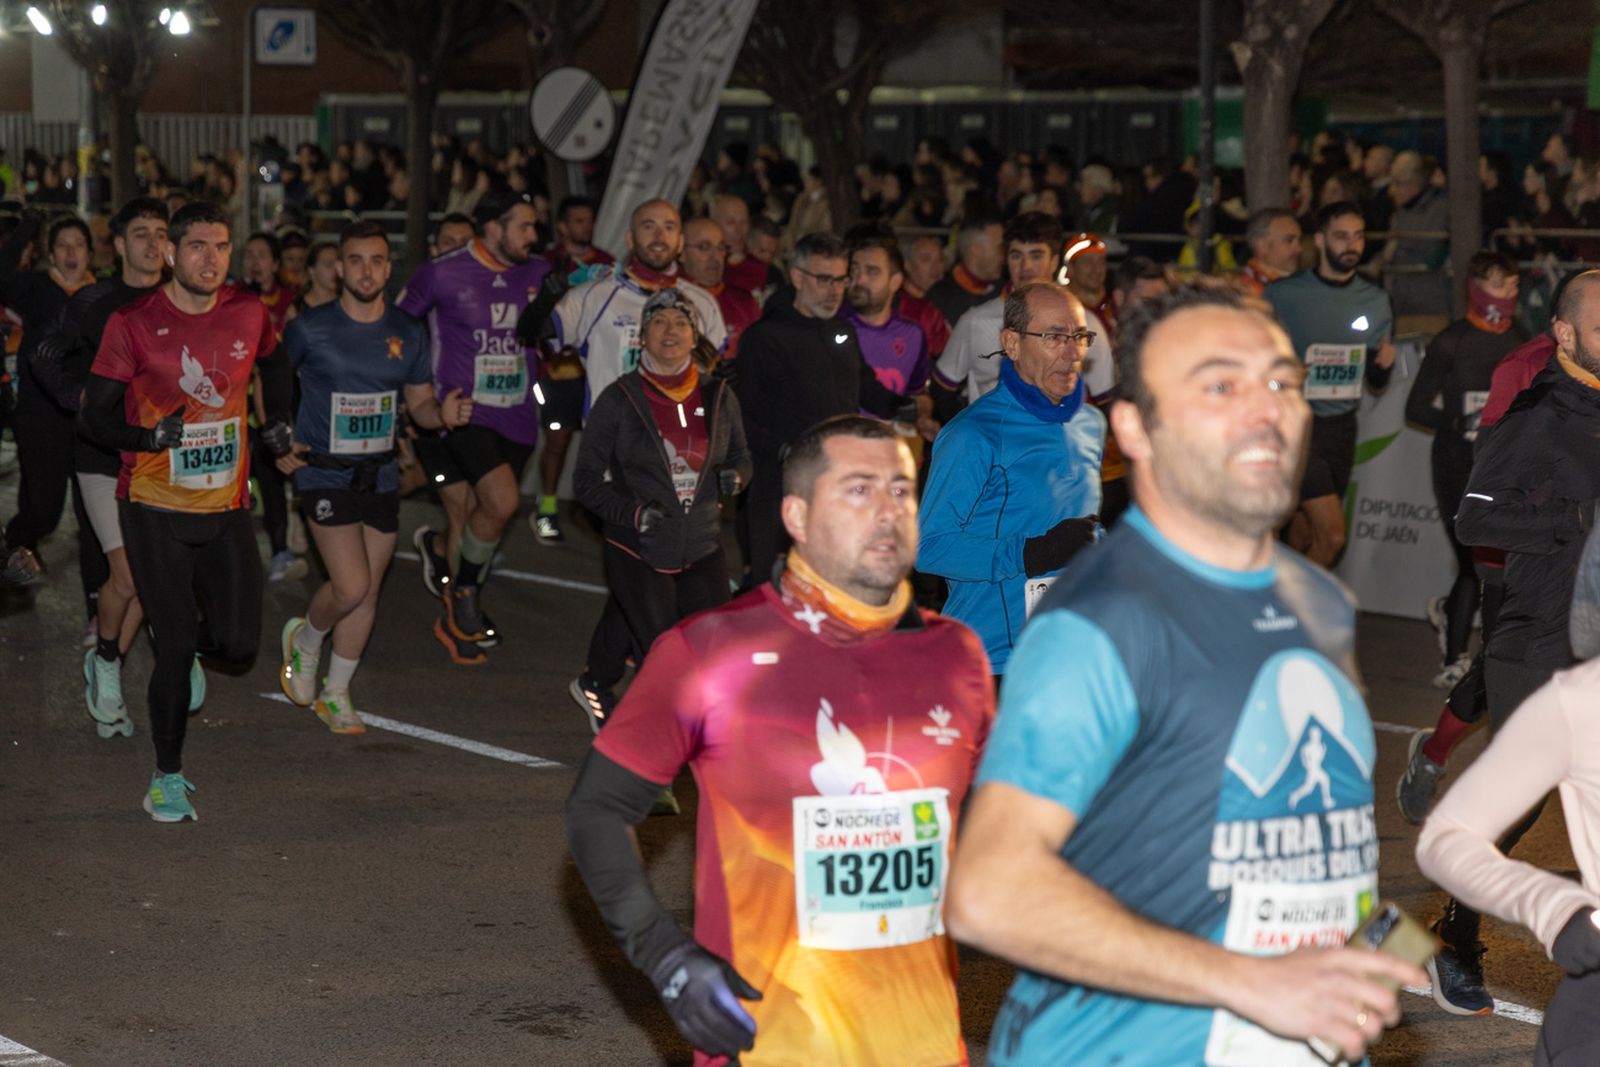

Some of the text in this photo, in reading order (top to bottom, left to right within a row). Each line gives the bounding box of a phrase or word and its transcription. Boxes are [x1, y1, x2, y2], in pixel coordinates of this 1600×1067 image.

[1313, 365, 1357, 380] 13759
[194, 382, 212, 400] 43
[348, 414, 383, 434] 8117
[180, 443, 234, 469] 13423
[1360, 497, 1441, 524] DIPUTACIÓ
[1356, 521, 1380, 540] DE
[834, 813, 882, 829] NOCHE
[883, 812, 901, 827] DE
[815, 832, 848, 849] SAN
[852, 828, 902, 848] ANTÓN
[1210, 813, 1323, 861] ULTRA
[1325, 803, 1377, 850] TRA
[816, 845, 935, 897] 13205
